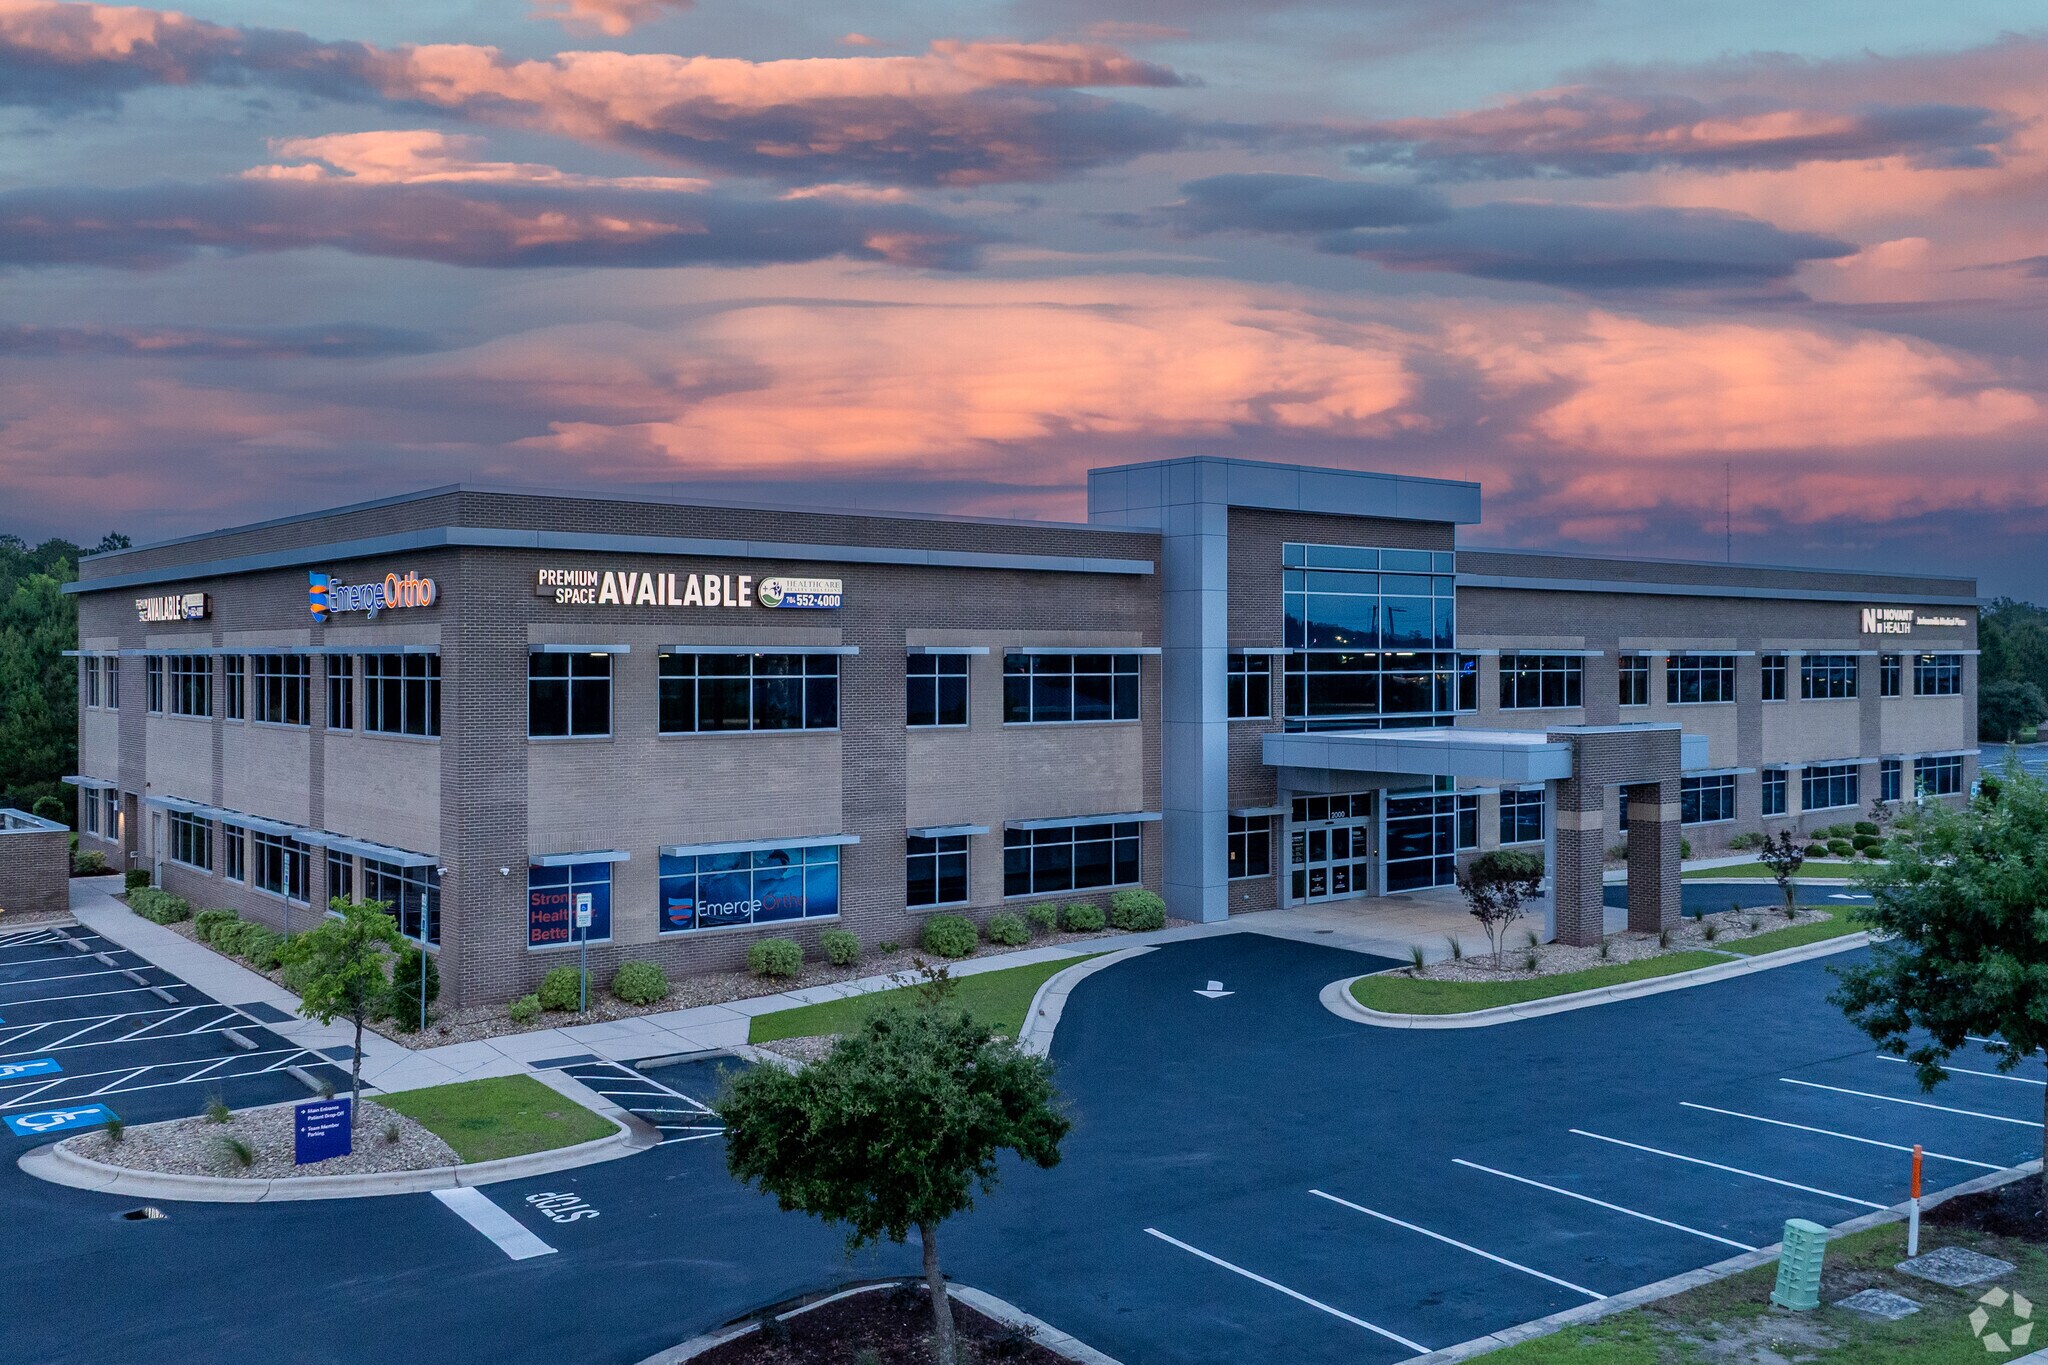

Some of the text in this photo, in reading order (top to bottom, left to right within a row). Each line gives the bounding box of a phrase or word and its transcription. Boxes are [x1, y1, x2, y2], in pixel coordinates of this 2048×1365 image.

[538, 569, 598, 586] PREMIUM
[786, 580, 840, 588] HEALTHCARE
[329, 570, 433, 620] EmergeOrtho
[555, 588, 596, 604] SPACE
[598, 571, 752, 607] AVAILABLE
[1883, 609, 1914, 621] NOVANT
[1883, 622, 1911, 634] HEALTH
[1331, 810, 1345, 818] 2000
[526, 1192, 600, 1223] STOP
